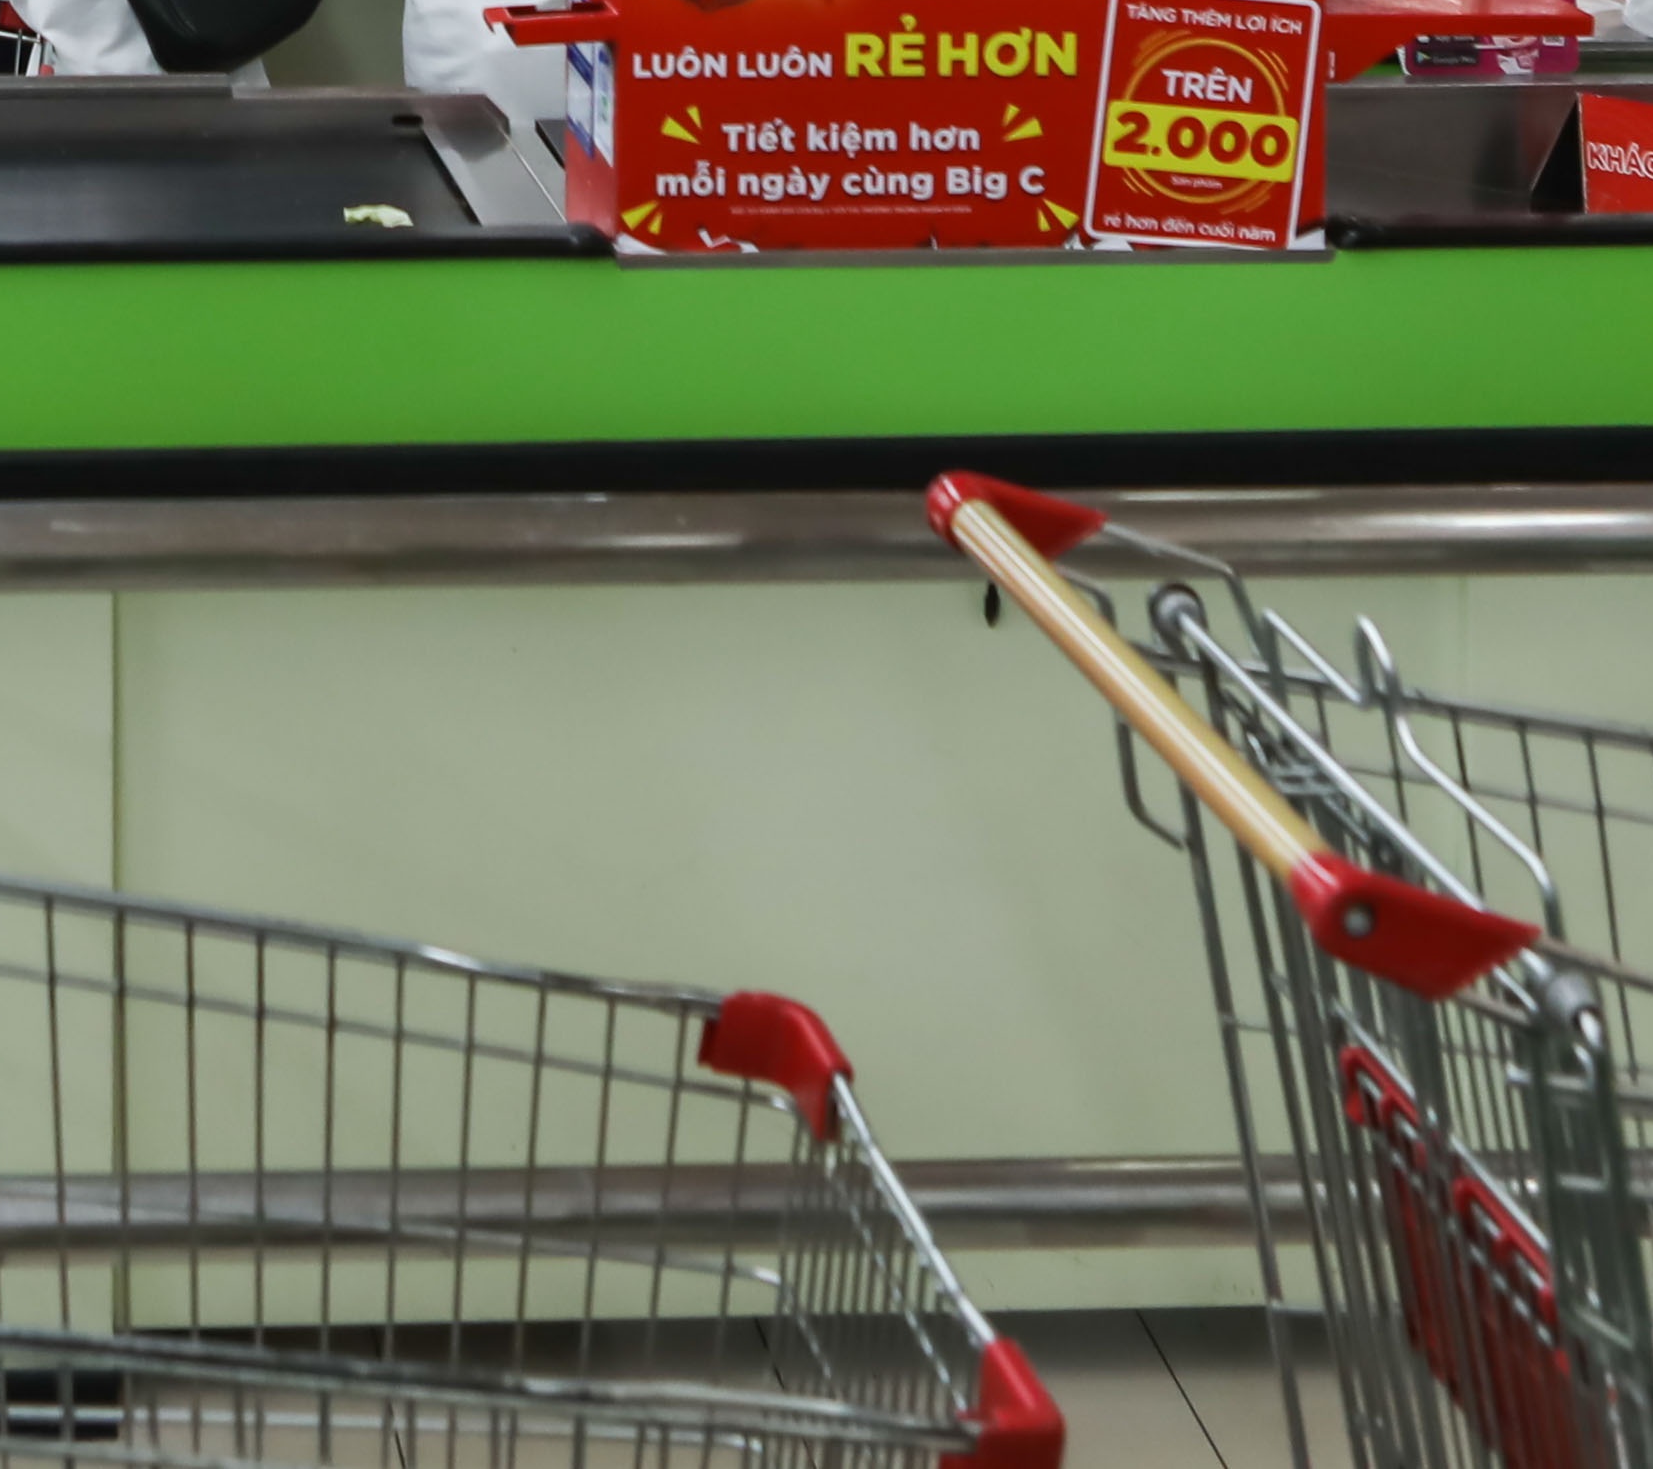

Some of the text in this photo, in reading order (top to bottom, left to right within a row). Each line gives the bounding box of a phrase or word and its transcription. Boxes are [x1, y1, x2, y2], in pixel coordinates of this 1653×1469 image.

[1126, 3, 1178, 24] TĂNG
[1181, 7, 1232, 29] THÊM
[1237, 12, 1267, 35] LỢI
[632, 13, 1079, 79] LUÔN LUÔN RẺ HƠN
[1161, 66, 1253, 104] TRÊN
[722, 117, 982, 160] Tiết kiệm hơn
[1113, 110, 1291, 169] 2.000
[656, 157, 1045, 206] mỗi ngày cùng Big C
[1125, 212, 1158, 231] hơn
[1162, 214, 1195, 236] đến
[1199, 216, 1235, 239] cuối
[1237, 220, 1276, 243] năm
